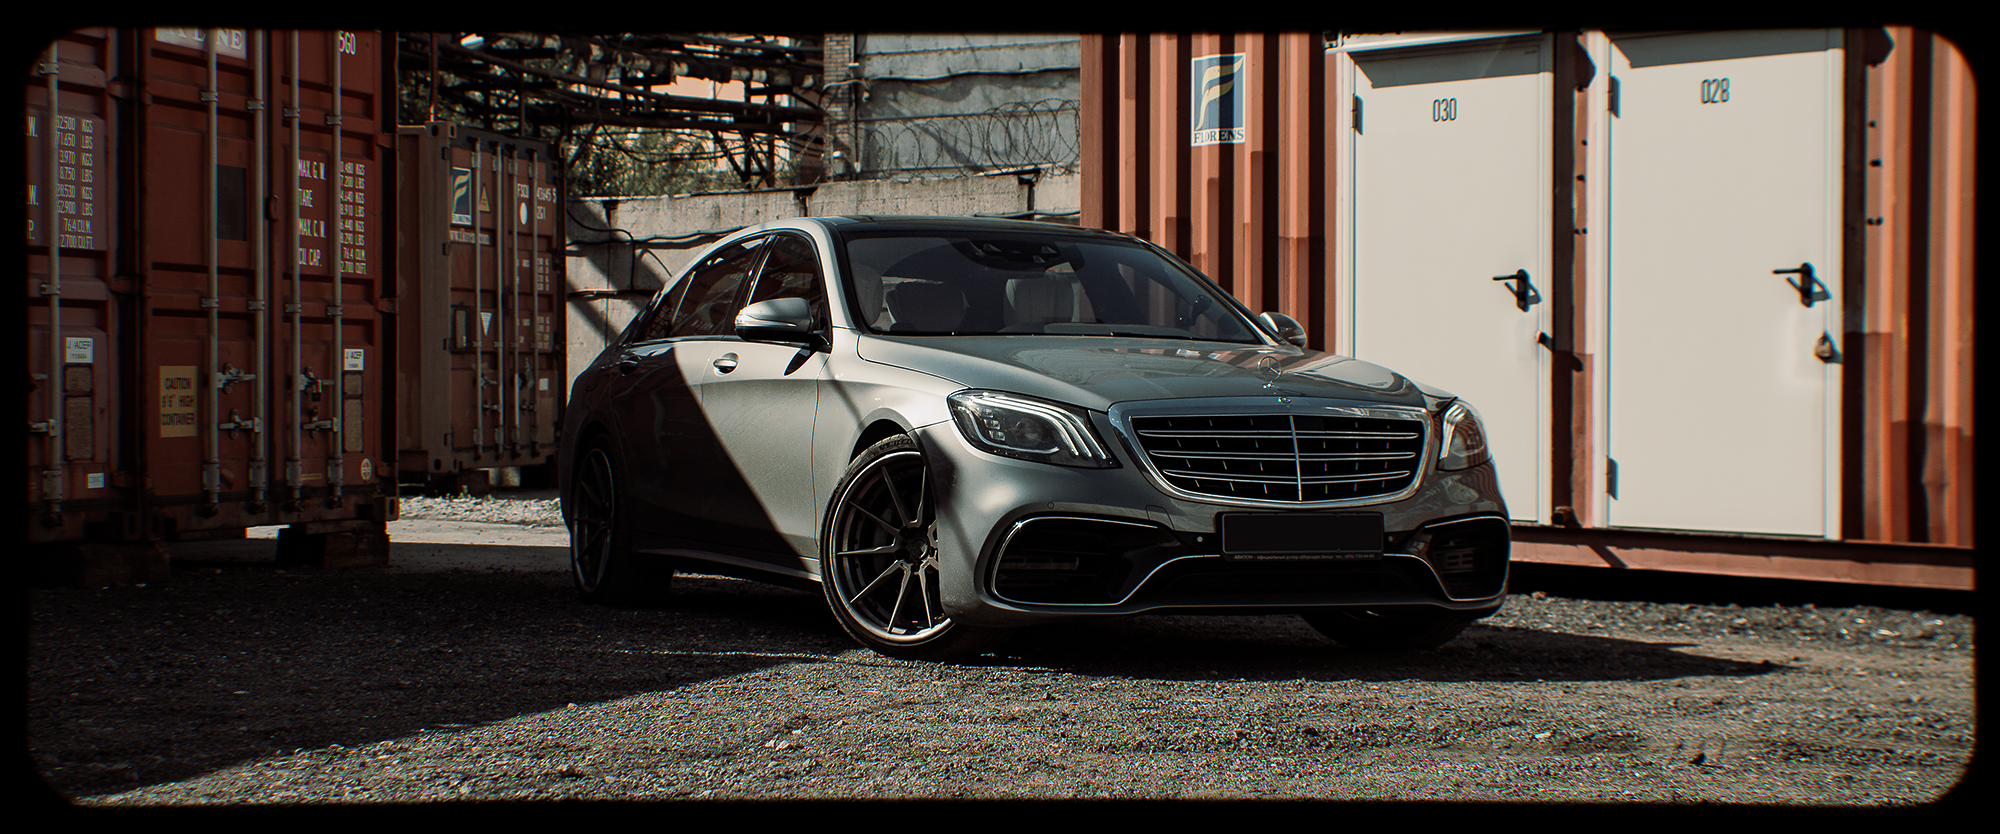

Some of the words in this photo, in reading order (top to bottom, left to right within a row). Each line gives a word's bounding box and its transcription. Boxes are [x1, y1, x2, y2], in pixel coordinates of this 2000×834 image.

[193, 26, 243, 50] LNE
[339, 31, 356, 55] 5G0
[1701, 78, 1729, 104] 028
[1432, 98, 1457, 122] 030
[164, 377, 193, 391] CAUTION
[178, 394, 196, 408] HIGH
[161, 412, 197, 426] CONTAINER
